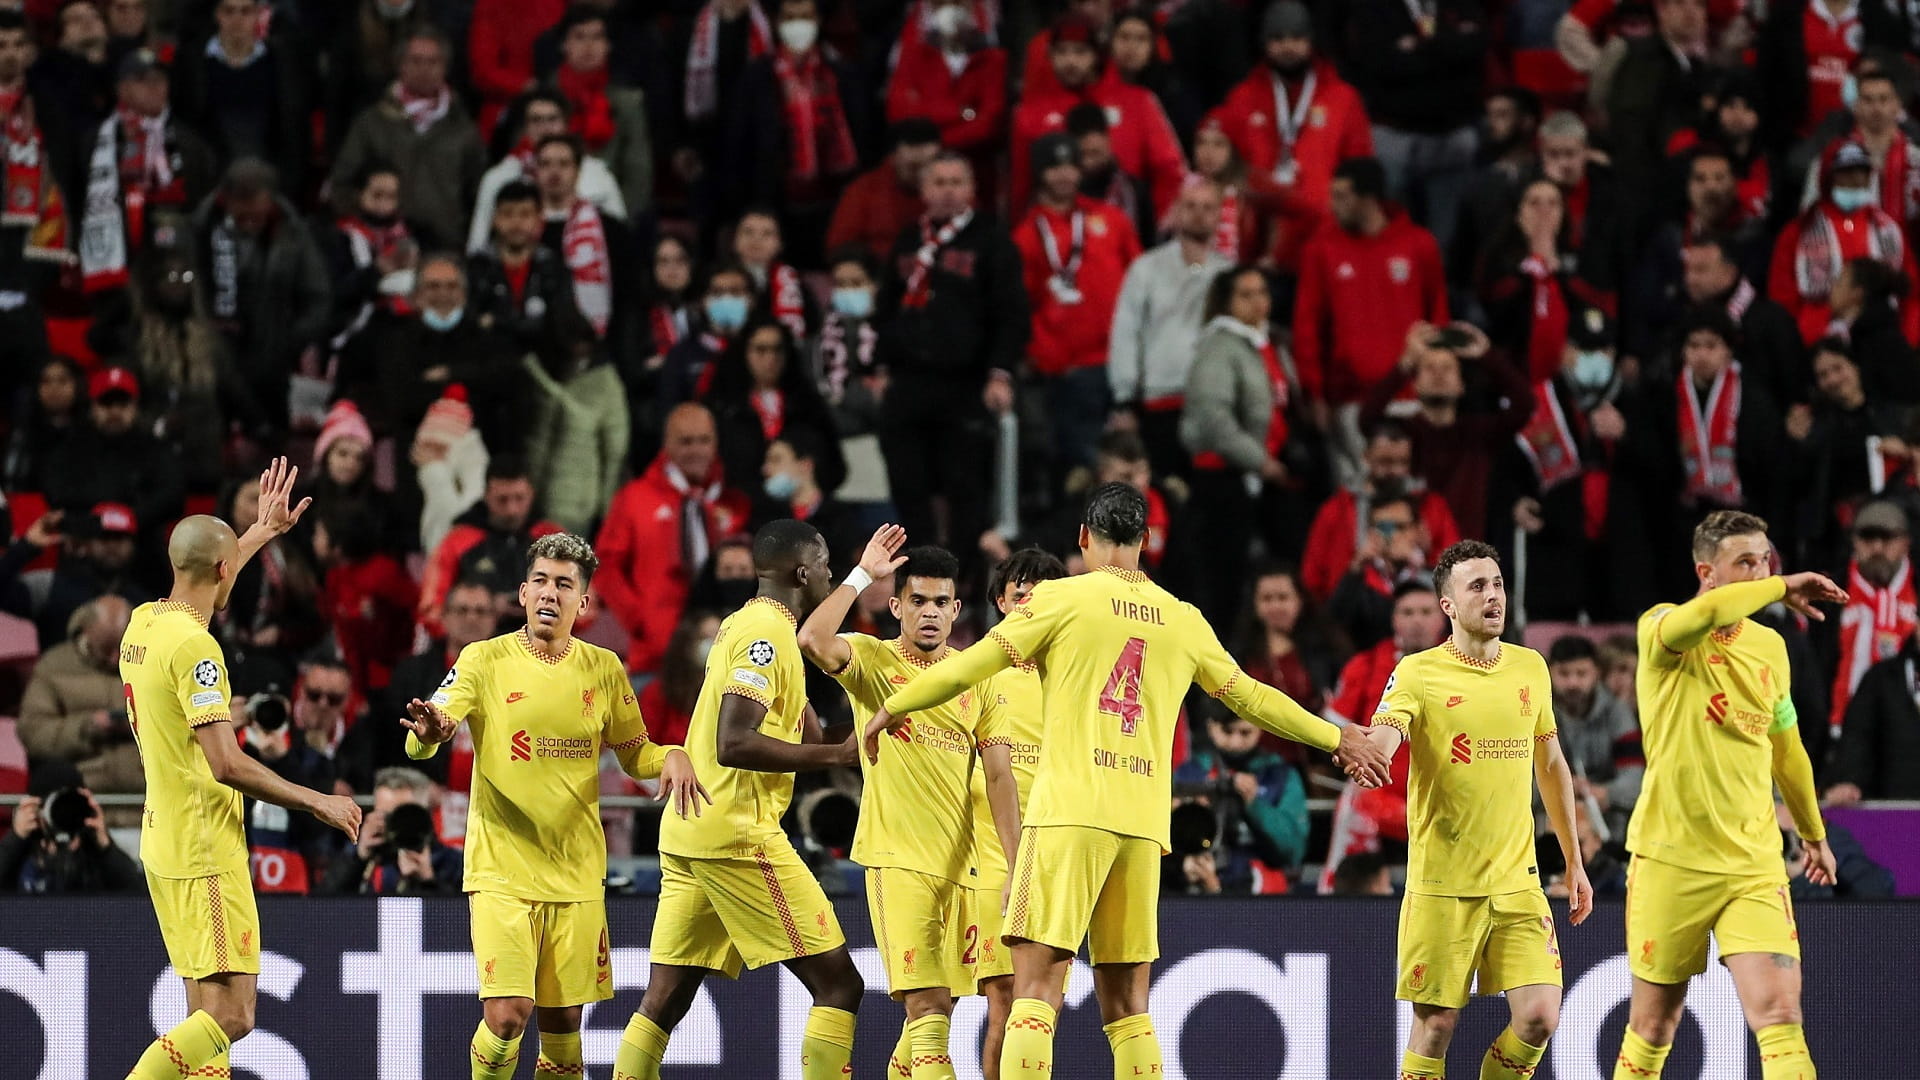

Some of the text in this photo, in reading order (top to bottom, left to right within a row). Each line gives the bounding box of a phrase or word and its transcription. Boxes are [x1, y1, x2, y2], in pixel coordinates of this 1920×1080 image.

[1111, 597, 1165, 626] VIRGIL
[1098, 636, 1148, 738] 4
[536, 735, 592, 748] standard
[1477, 737, 1529, 748] standard
[536, 747, 594, 759] chartered
[1094, 747, 1120, 770] SIDE
[1129, 754, 1155, 778] SIDE
[1476, 749, 1529, 760] chartered
[596, 927, 608, 968] 9
